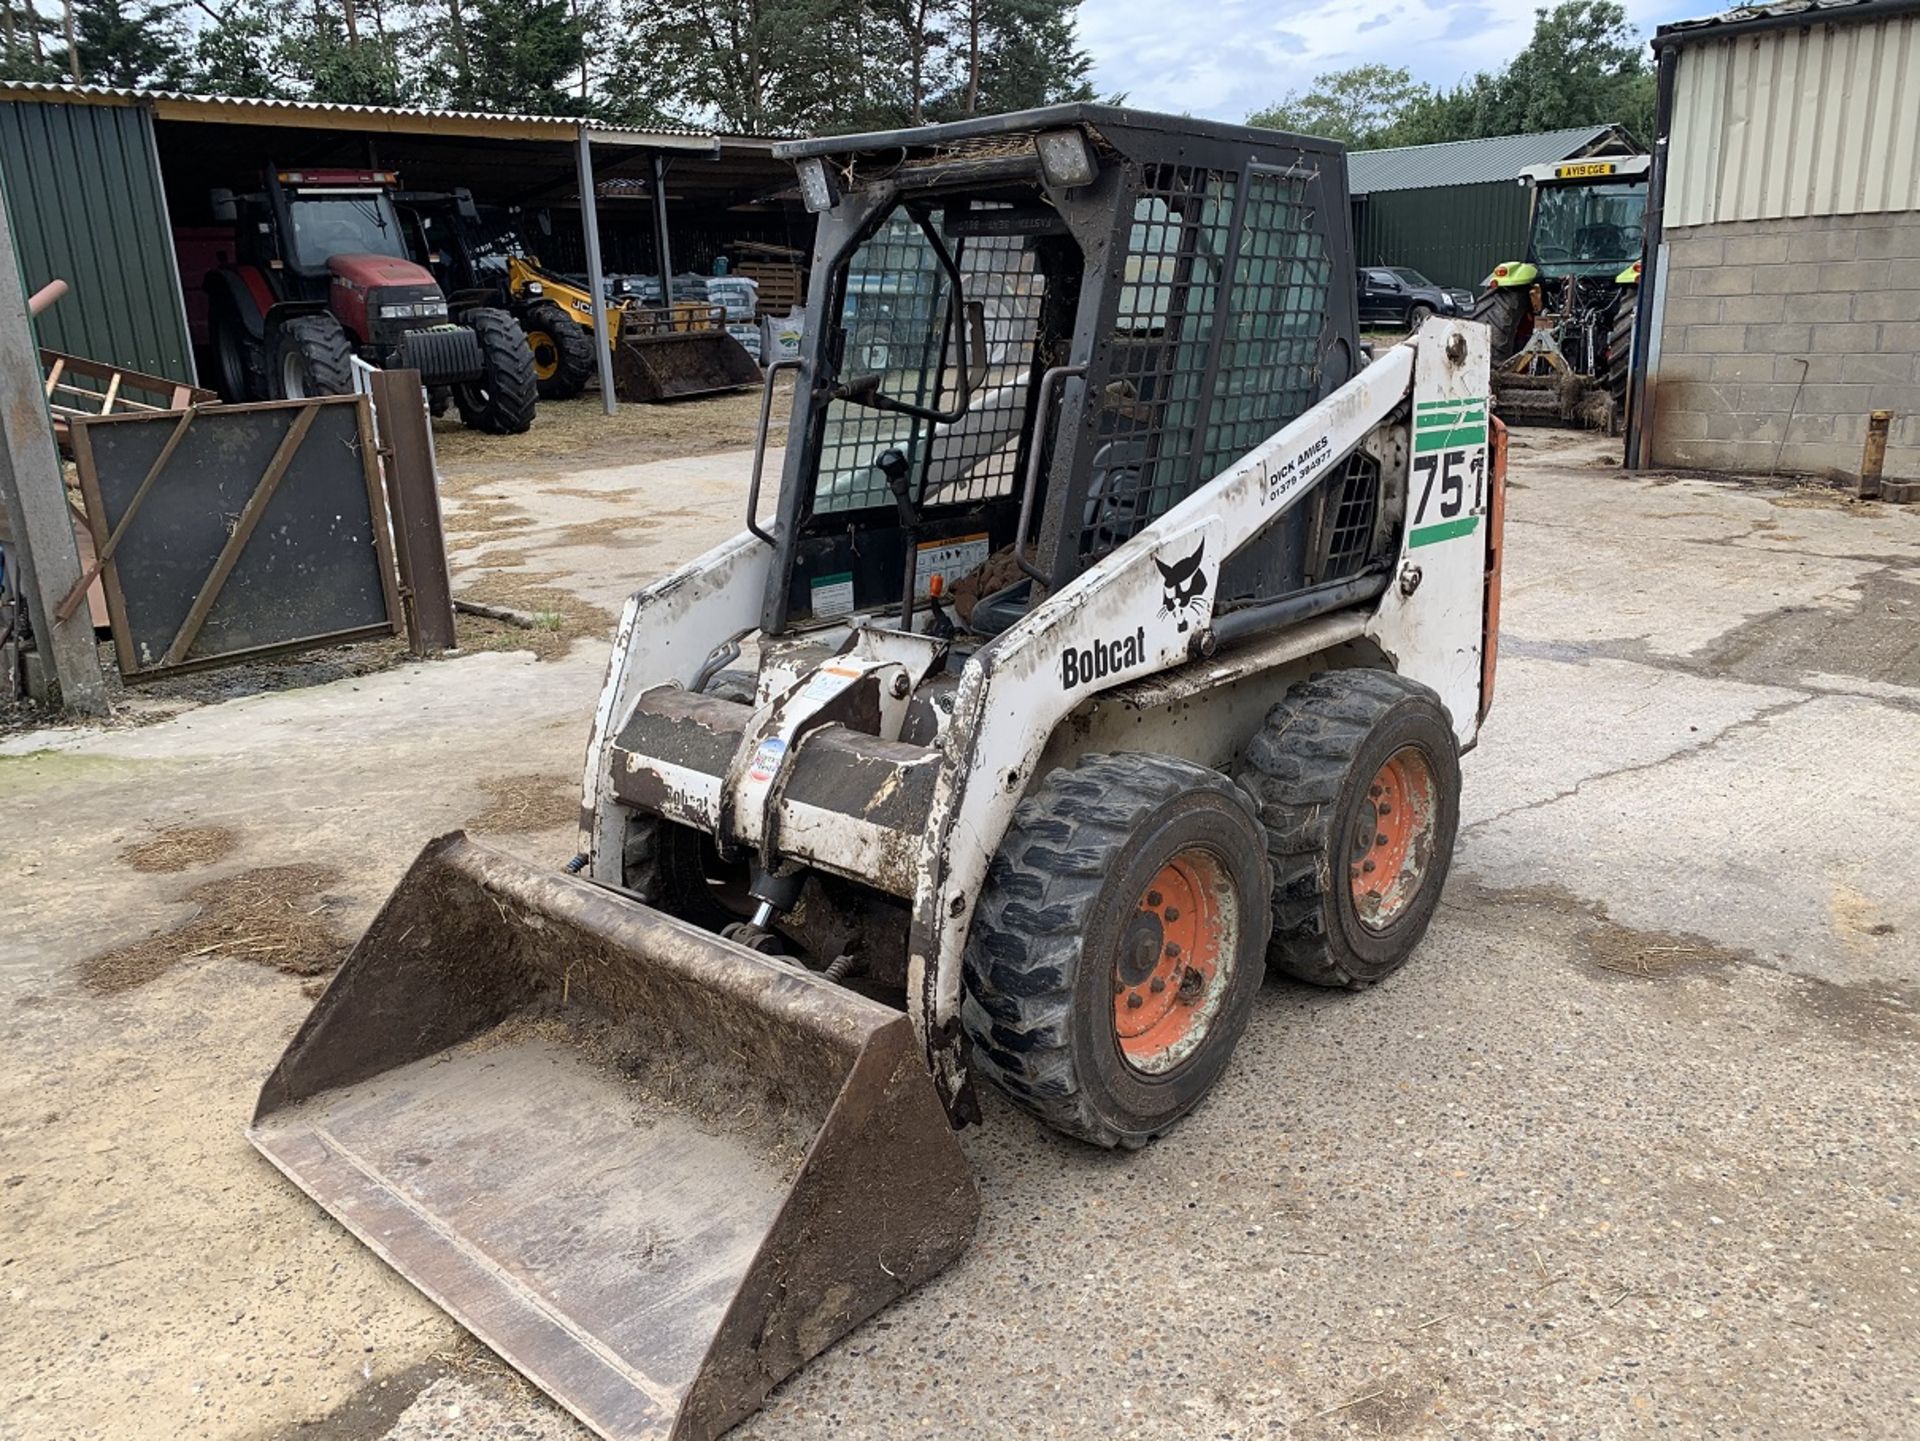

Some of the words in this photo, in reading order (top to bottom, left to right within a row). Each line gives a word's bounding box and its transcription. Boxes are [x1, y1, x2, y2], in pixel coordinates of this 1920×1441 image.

[1566, 166, 1586, 177] AY19
[1270, 460, 1295, 486] DICK
[1298, 435, 1328, 466] AMIES
[1062, 626, 1146, 691] Bobcat
